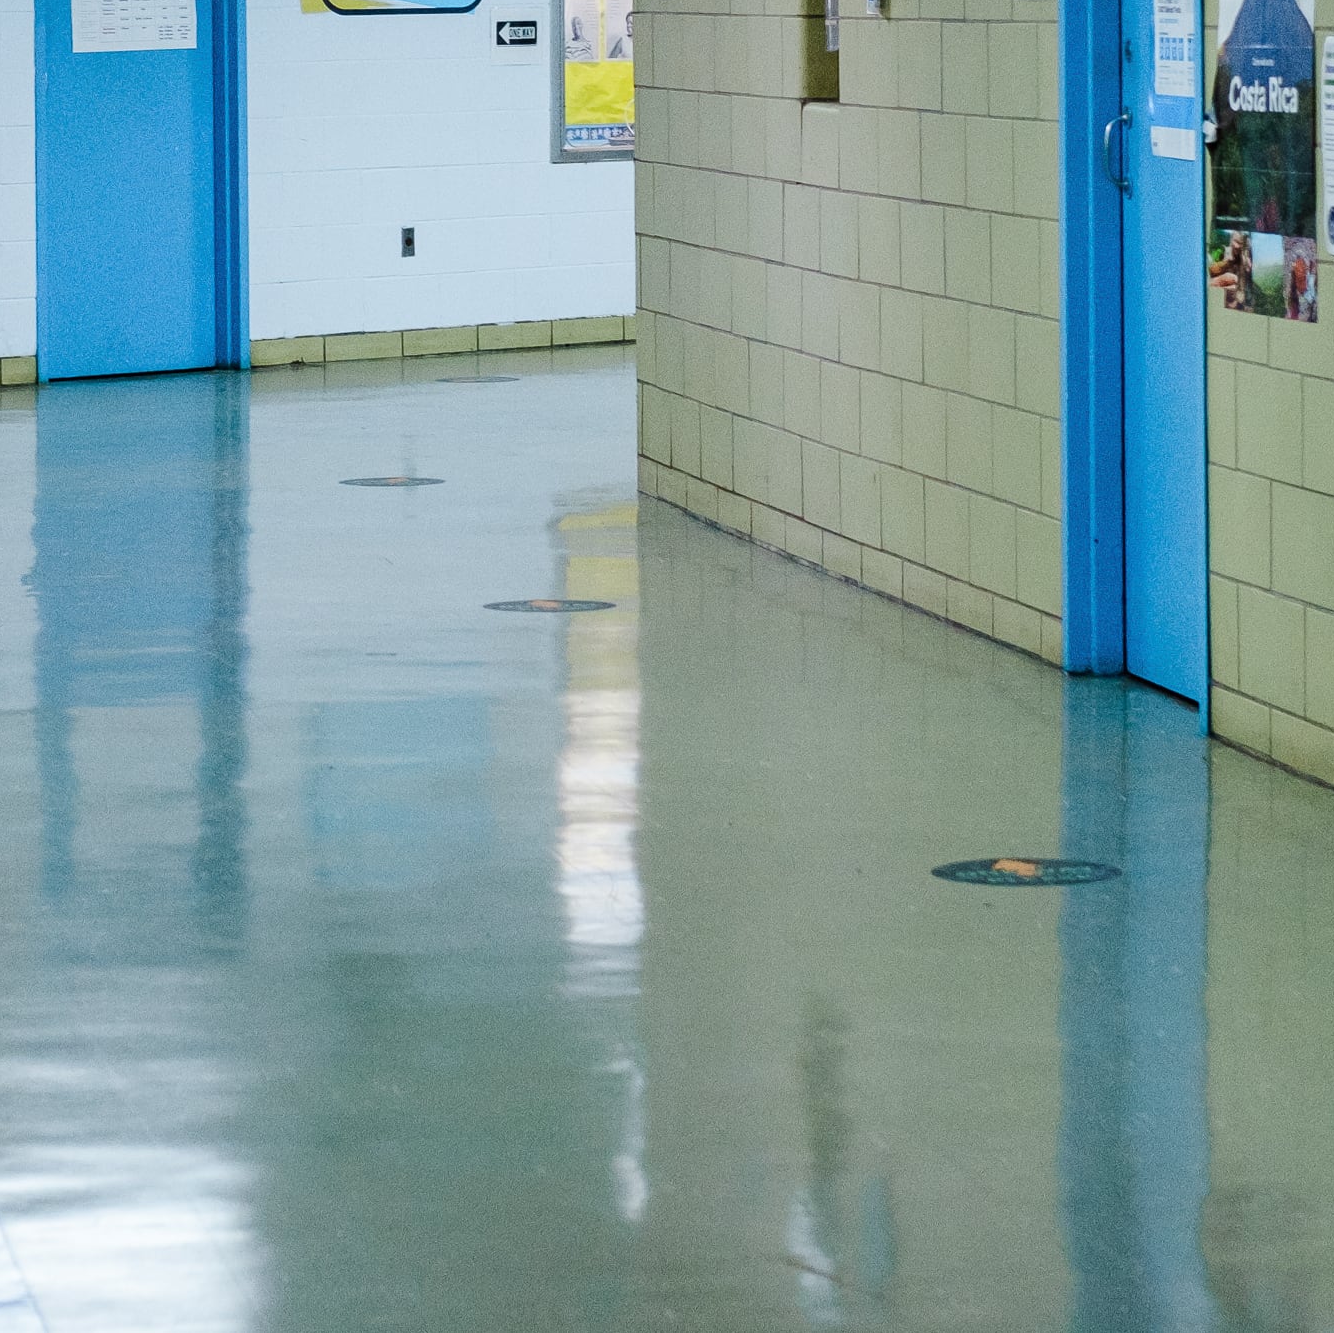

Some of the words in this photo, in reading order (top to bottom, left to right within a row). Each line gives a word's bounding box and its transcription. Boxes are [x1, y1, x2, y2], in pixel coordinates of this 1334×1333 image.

[509, 28, 521, 38] ONE
[522, 28, 534, 38] WAY
[1229, 75, 1267, 112] Costa
[1268, 75, 1300, 114] Rica
